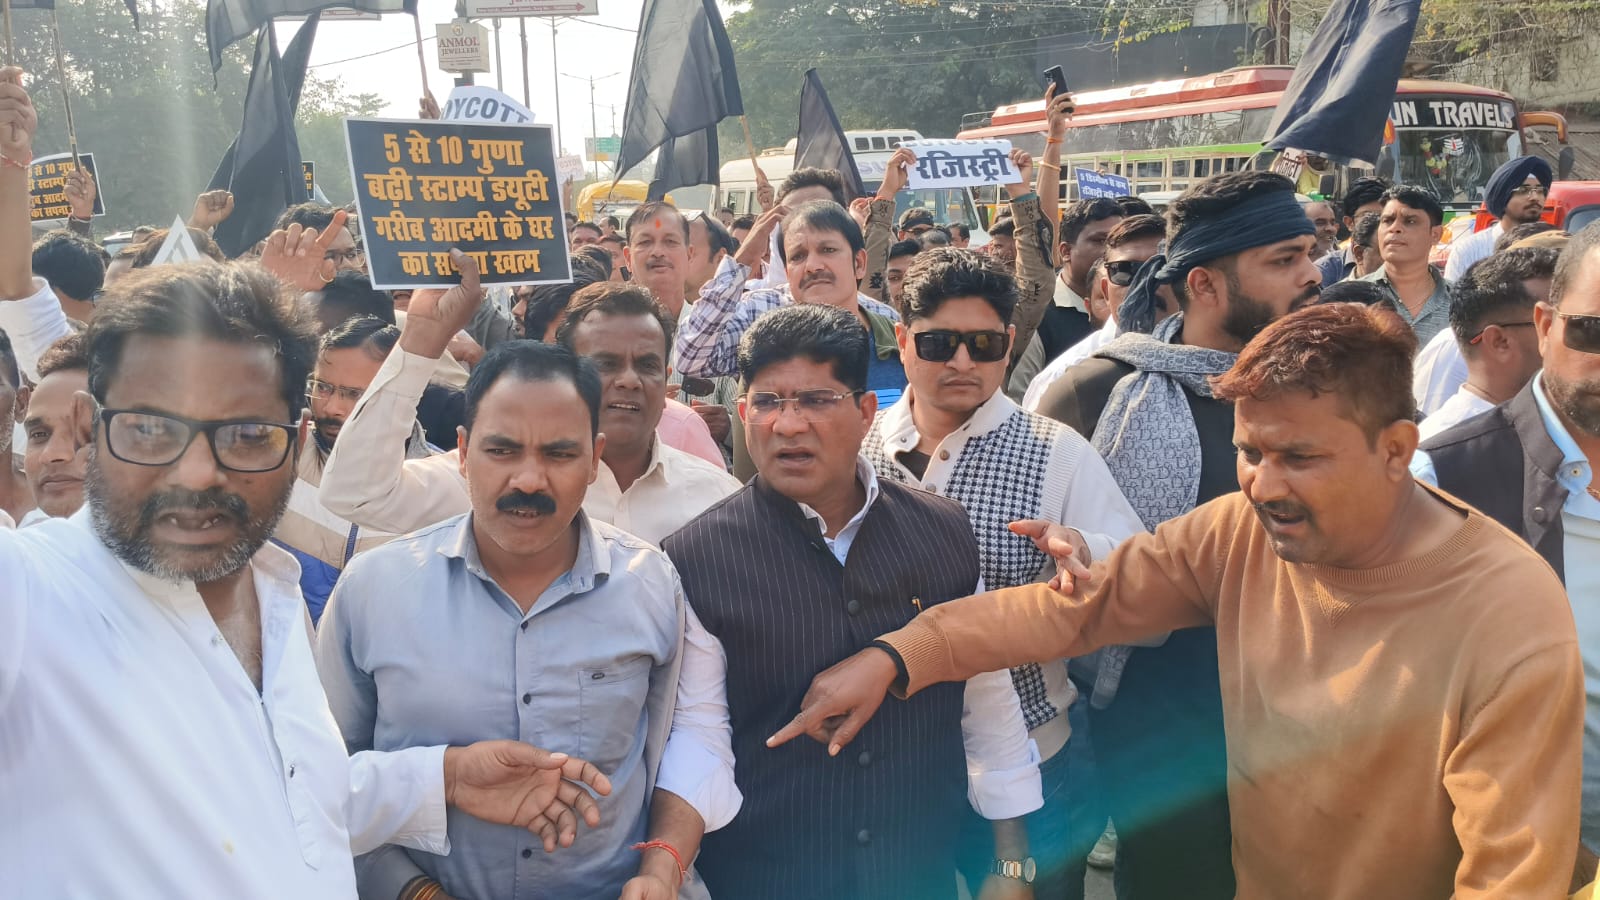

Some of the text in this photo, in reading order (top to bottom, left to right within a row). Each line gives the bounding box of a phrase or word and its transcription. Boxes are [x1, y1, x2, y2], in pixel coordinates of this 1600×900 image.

[438, 37, 480, 48] ANMOL
[441, 47, 479, 56] JEWELLERS
[1429, 101, 1513, 129] TRAVELS
[383, 129, 524, 174] 5 से 10 गुणा
[915, 148, 1012, 182] रजिस्ट्री
[45, 163, 56, 175] 10
[363, 166, 413, 208] बढ़ी
[416, 175, 486, 202] स्टाम्प
[372, 210, 555, 243] गरीब आदमी के घर
[398, 251, 431, 276] का
[490, 250, 541, 274] खत्म
